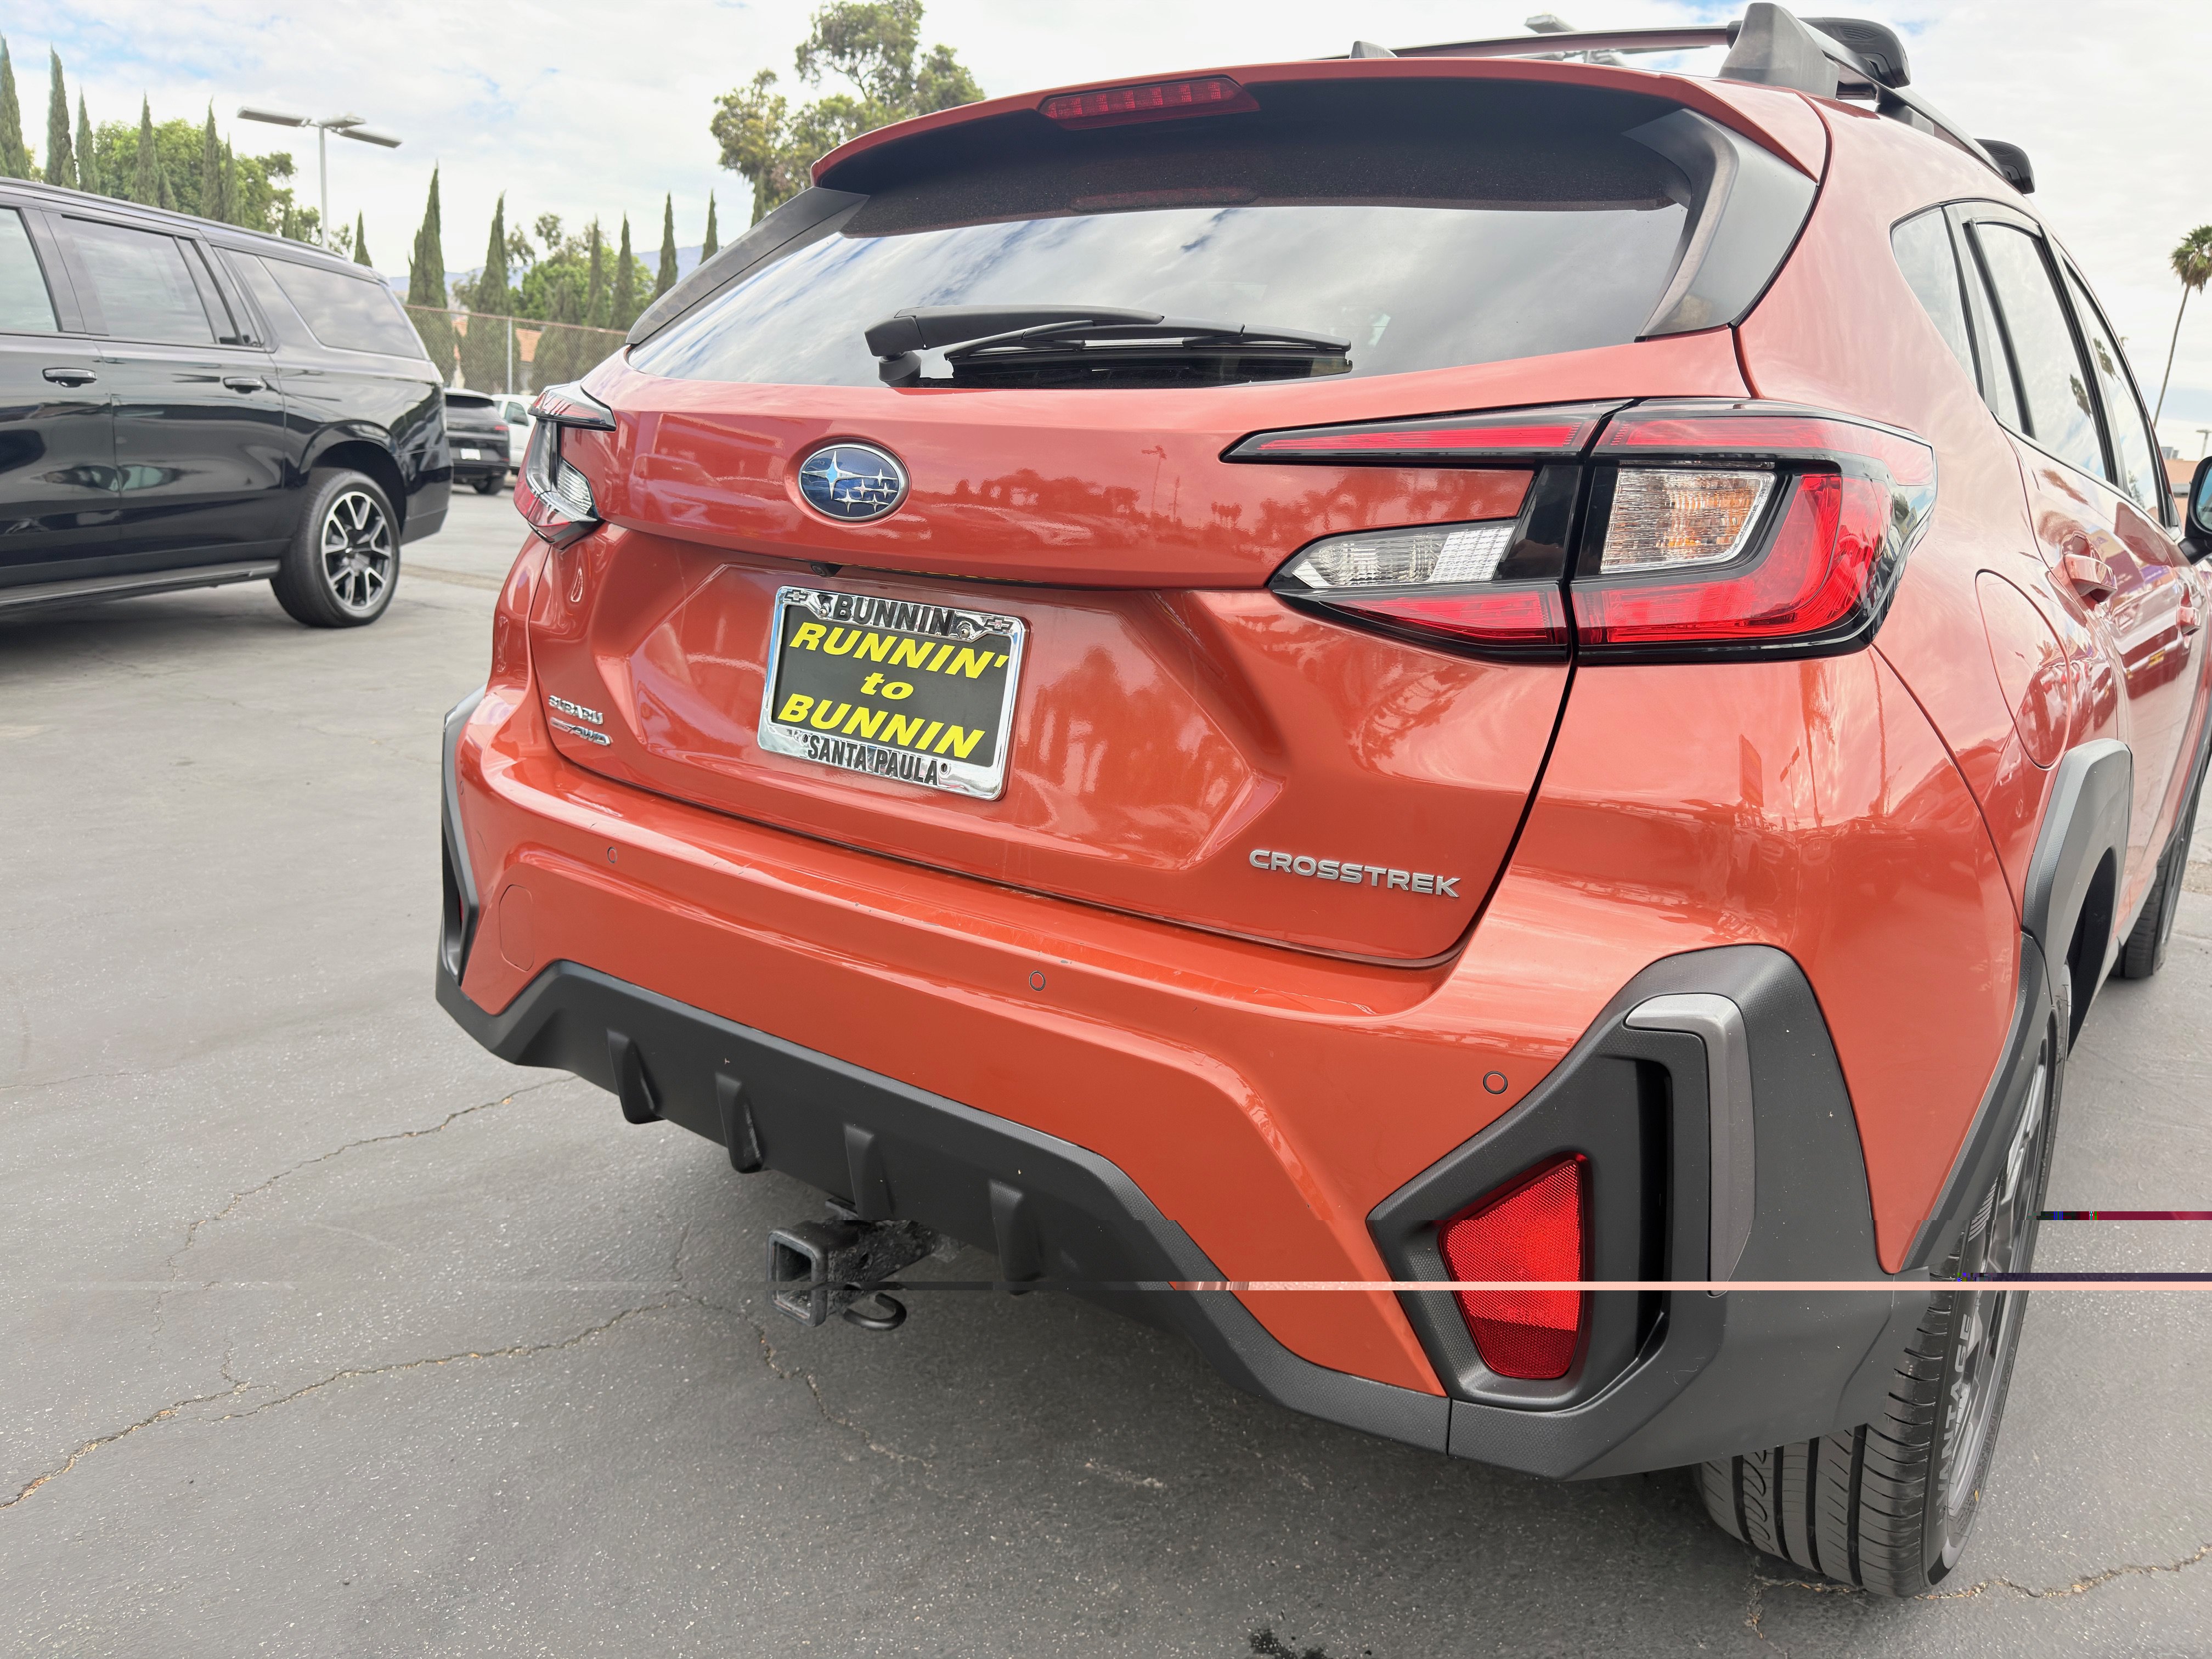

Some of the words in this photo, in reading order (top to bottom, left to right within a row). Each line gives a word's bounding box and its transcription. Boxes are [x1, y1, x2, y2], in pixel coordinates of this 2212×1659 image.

[833, 594, 955, 636] BUNNIN
[789, 622, 1009, 679] RUNNIN'
[860, 672, 914, 700] to
[548, 695, 603, 725] SUBARU
[777, 693, 985, 759] BUNNIN
[569, 725, 611, 746] AWD
[808, 735, 867, 772] SANTA
[874, 749, 938, 786] PAULA
[1249, 849, 1461, 898] CROSSTREK
